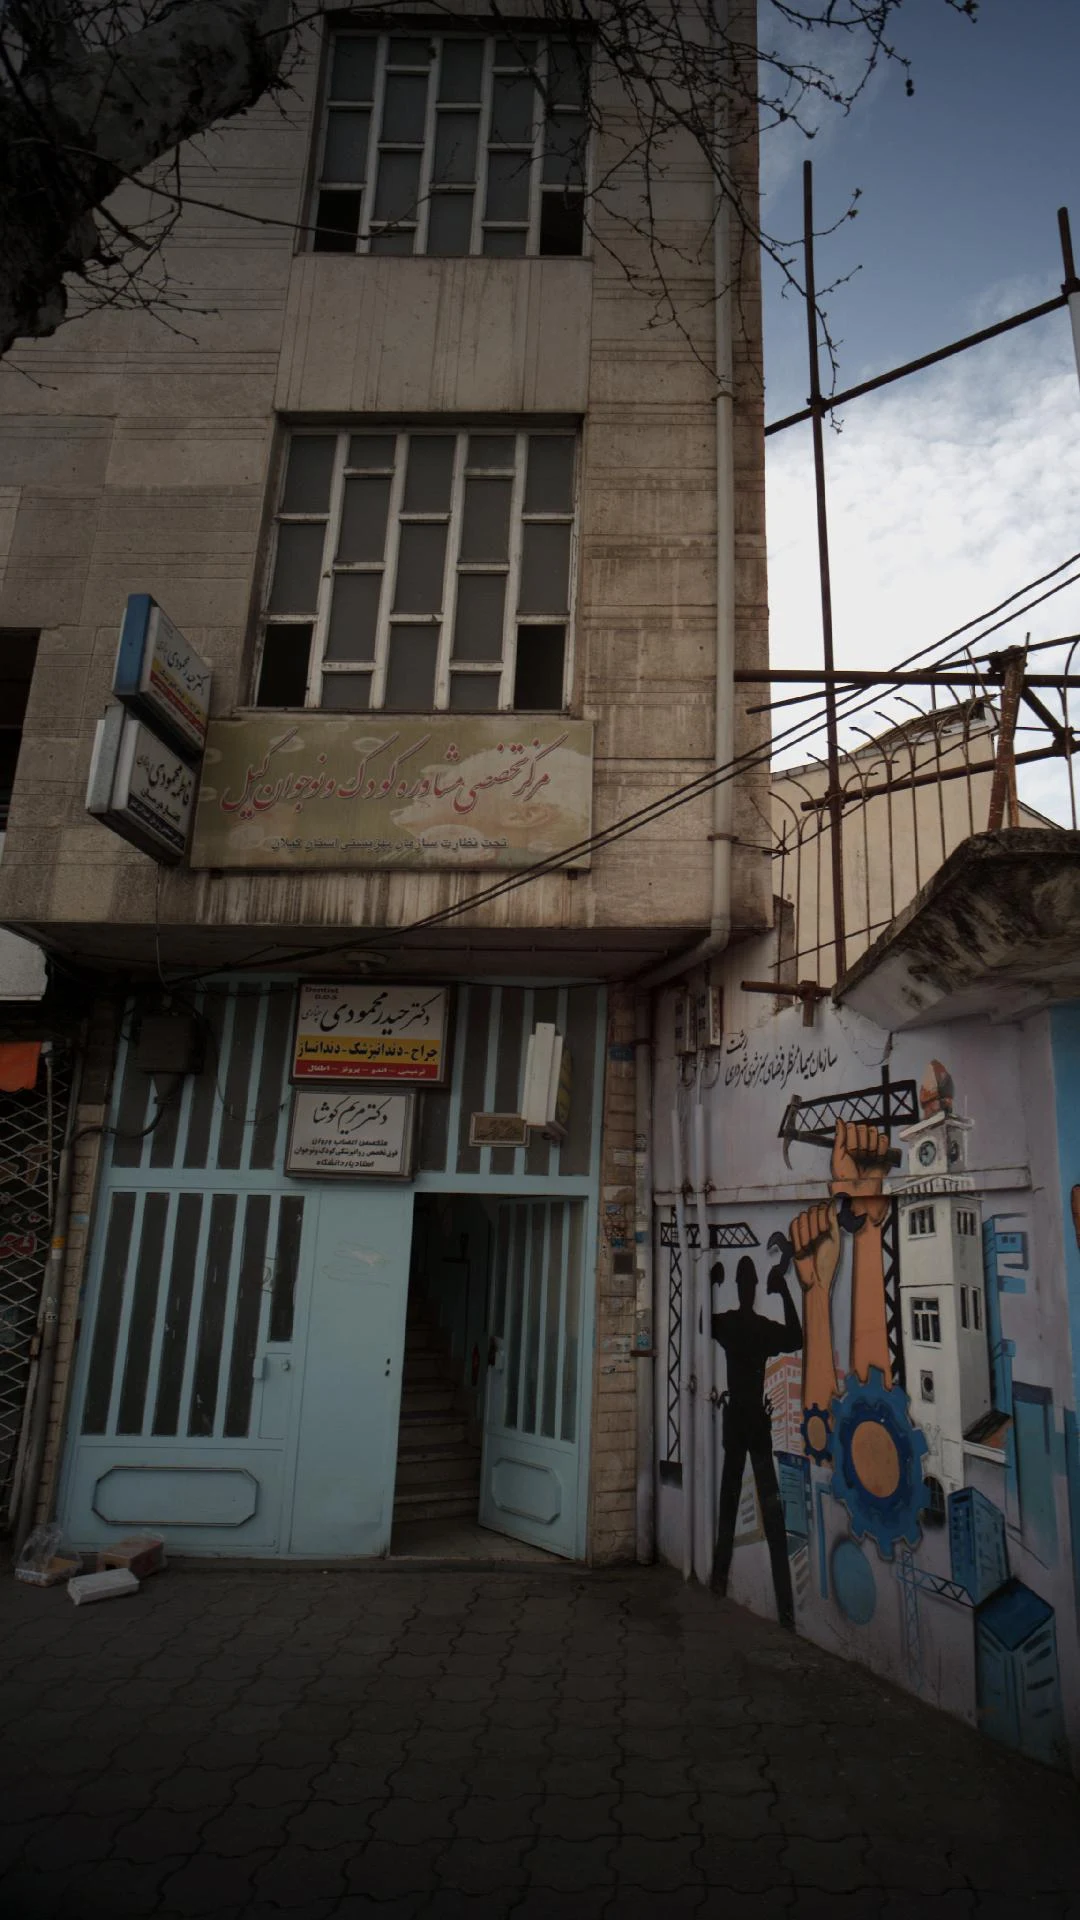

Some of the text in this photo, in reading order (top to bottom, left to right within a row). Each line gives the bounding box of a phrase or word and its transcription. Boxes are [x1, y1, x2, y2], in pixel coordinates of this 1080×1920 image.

[252, 752, 328, 814] نوجوان
[336, 731, 431, 800] کودک
[396, 743, 466, 799] مشاوره
[452, 742, 532, 814] تخصصی
[511, 731, 569, 801] مرکز
[319, 778, 336, 799] و
[271, 836, 508, 853] تحت نظارت سازمان بهزیستی استان گیلان
[320, 991, 389, 1032] محمودی
[371, 1008, 410, 1035] حیدر
[399, 993, 442, 1031] دکتر
[297, 1040, 438, 1062] جراح دندانپزشک دندانساز
[313, 1095, 392, 1135] دکتر مریم کوشا
